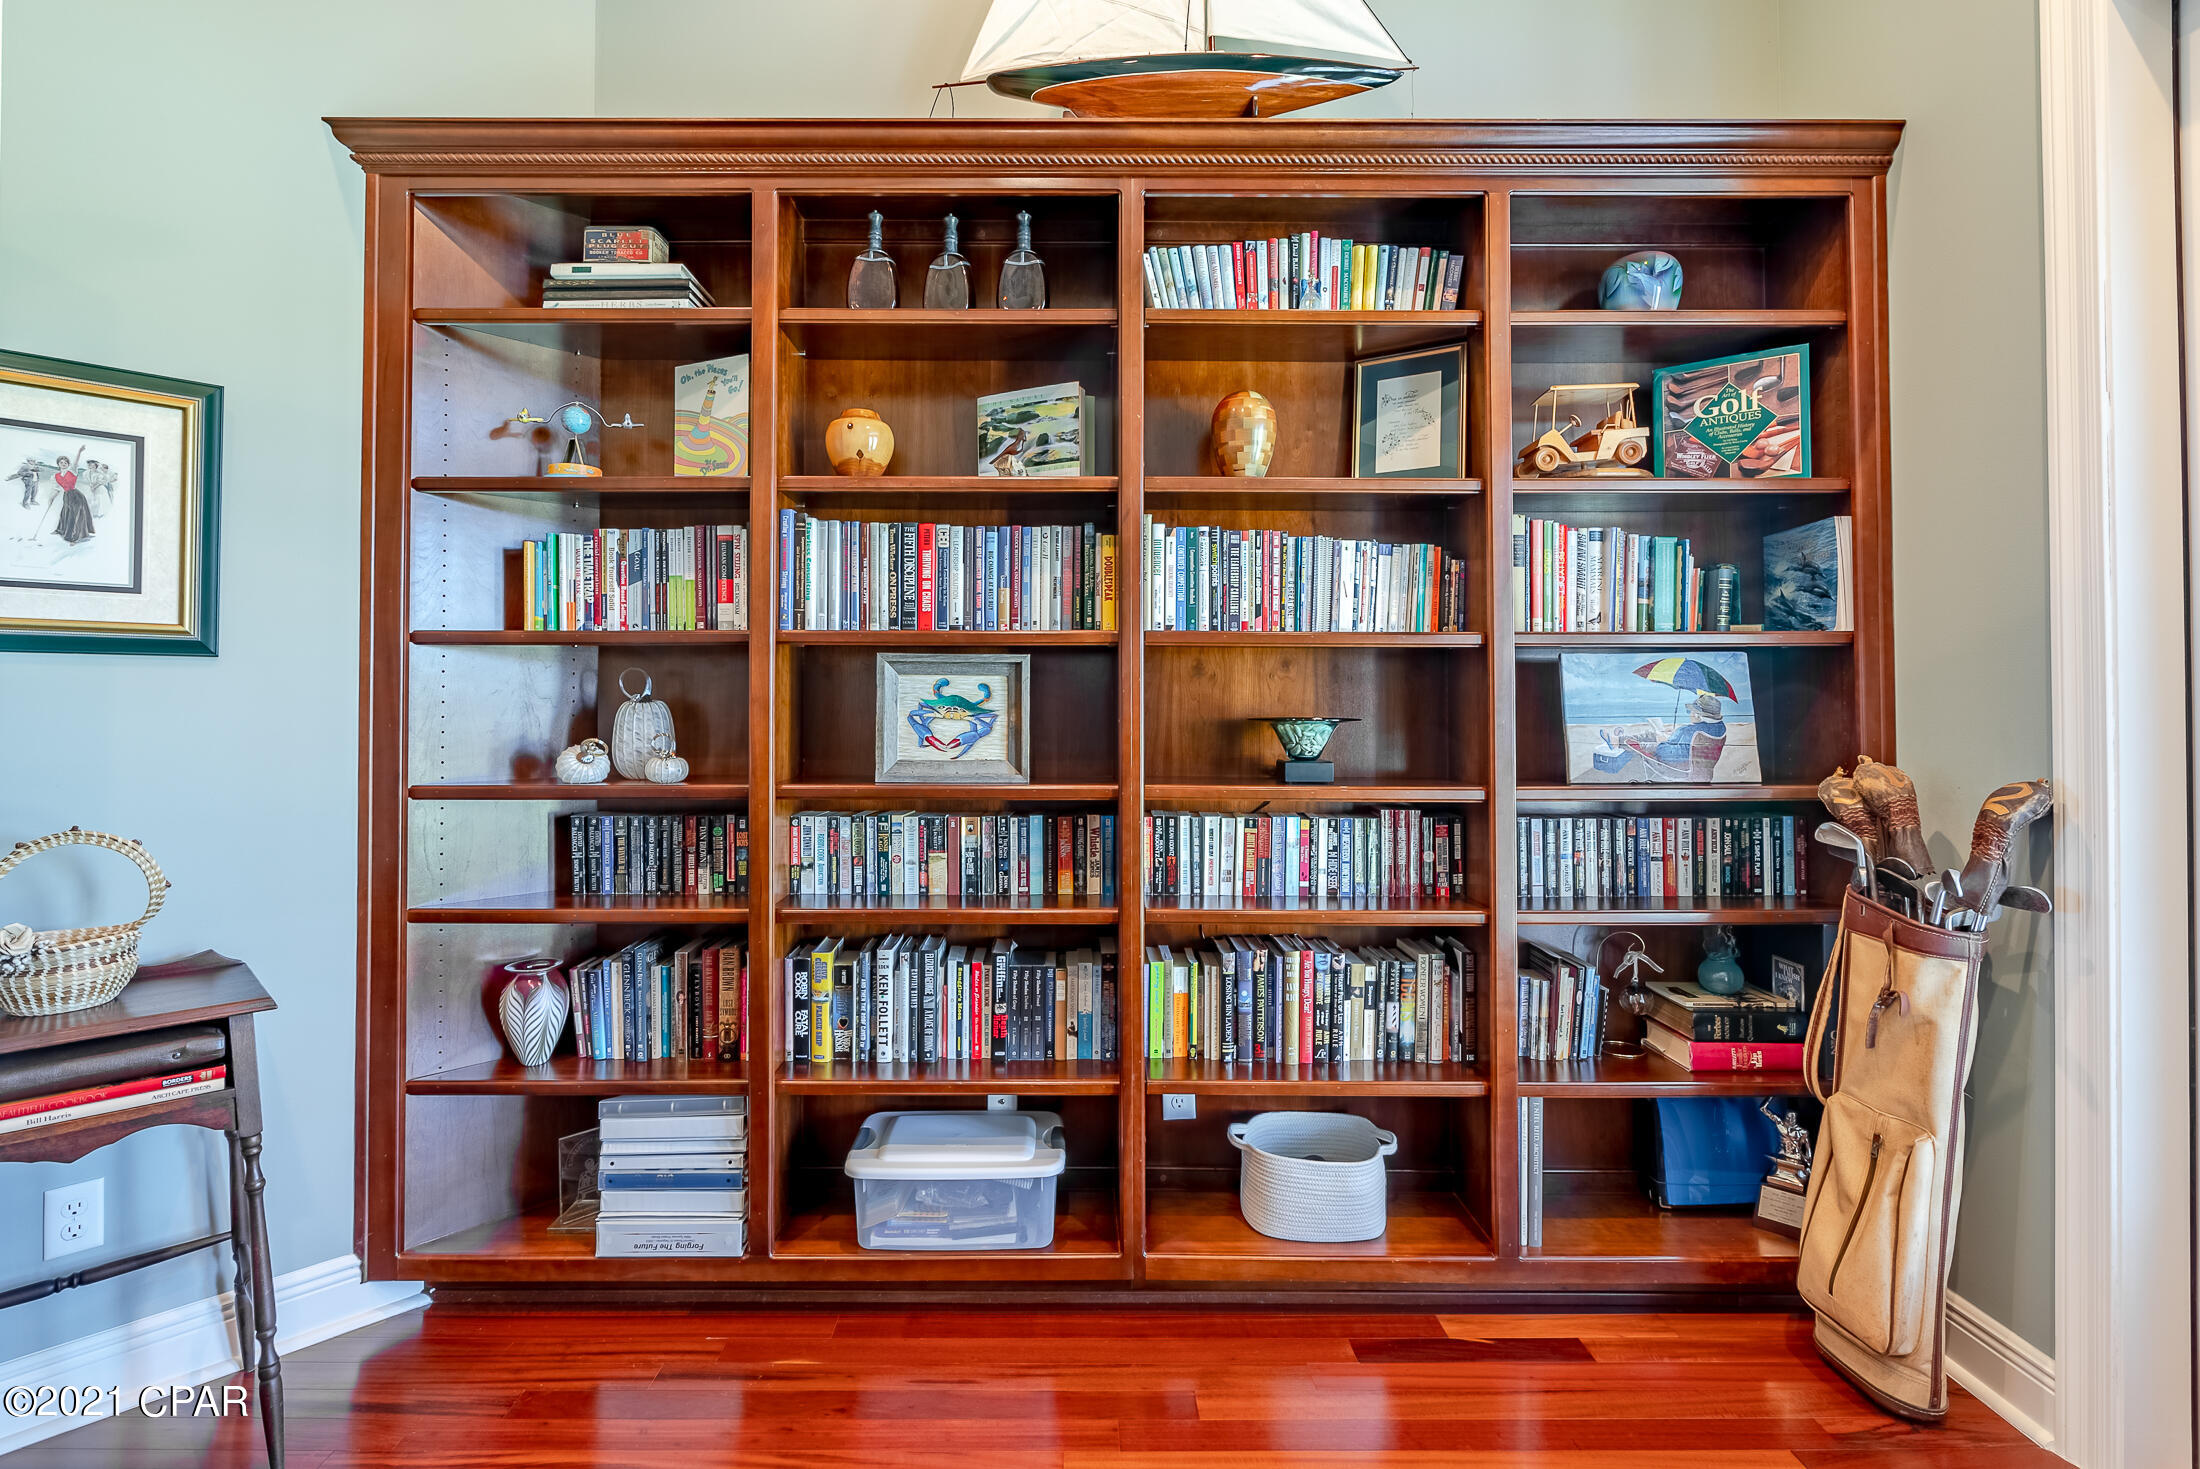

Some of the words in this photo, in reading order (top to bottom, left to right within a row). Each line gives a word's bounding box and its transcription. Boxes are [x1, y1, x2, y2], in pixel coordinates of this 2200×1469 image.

[694, 368, 705, 376] the
[706, 364, 728, 376] Places
[728, 380, 744, 394] Go!
[1693, 386, 1763, 418] Golf
[1700, 410, 1762, 427] ANTIQUES
[904, 533, 915, 556] FIFTH
[922, 550, 931, 578] THRIVING
[1153, 539, 1162, 576] Influencer
[890, 572, 896, 587] ON
[904, 558, 915, 600] DISCIPLINE
[922, 581, 931, 589] ON
[1104, 556, 1113, 601] DOUBLESPEAK
[922, 592, 931, 612] CHAOS
[714, 837, 723, 849] DAN
[1090, 828, 1099, 858] Whistle
[1652, 832, 1660, 842] ANN
[714, 850, 723, 872] BROWN
[722, 952, 734, 965] DAN
[925, 954, 934, 976] ELIZABETH
[722, 968, 734, 992] BROWN
[996, 956, 1005, 988] Griffin
[878, 975, 888, 995] KEN
[925, 977, 934, 995] GEORGE
[1304, 999, 1312, 1014] Dear?
[1400, 979, 1416, 1022] ICONS
[878, 1001, 888, 1046] FOLLETT
[162, 1076, 192, 1086] BORDERS
[48, 1092, 108, 1108] COOKBOOK
[151, 1091, 171, 1100] ARCH
[172, 1088, 189, 1097] CAPE
[190, 1084, 212, 1094] PRESS
[26, 1117, 42, 1126] Bill
[44, 1111, 72, 1124] Harris
